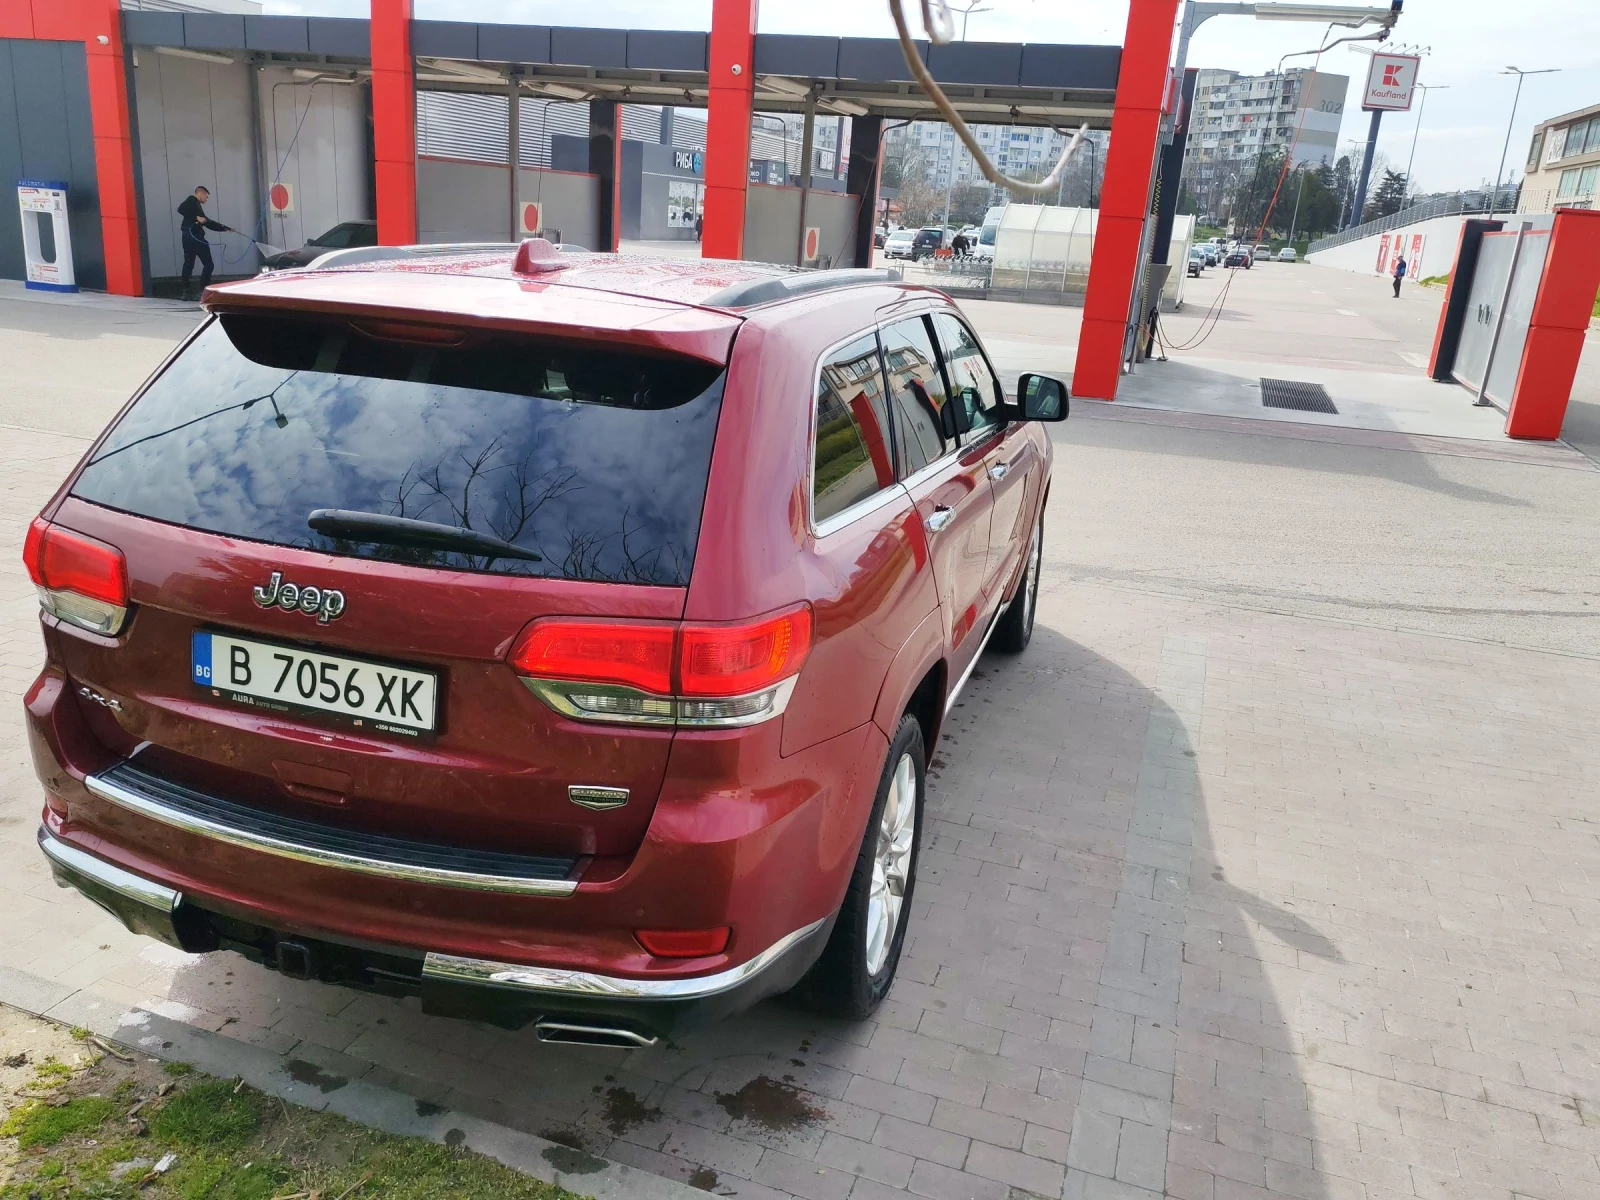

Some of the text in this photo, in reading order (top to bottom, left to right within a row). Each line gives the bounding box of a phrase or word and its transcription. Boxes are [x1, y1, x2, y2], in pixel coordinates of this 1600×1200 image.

[1371, 88, 1407, 100] Kaufland
[1318, 99, 1343, 115] 302
[675, 151, 693, 170] РИБА
[253, 571, 346, 625] Jeep
[195, 645, 425, 722] BG B 7056 XK
[232, 693, 255, 705] AURA
